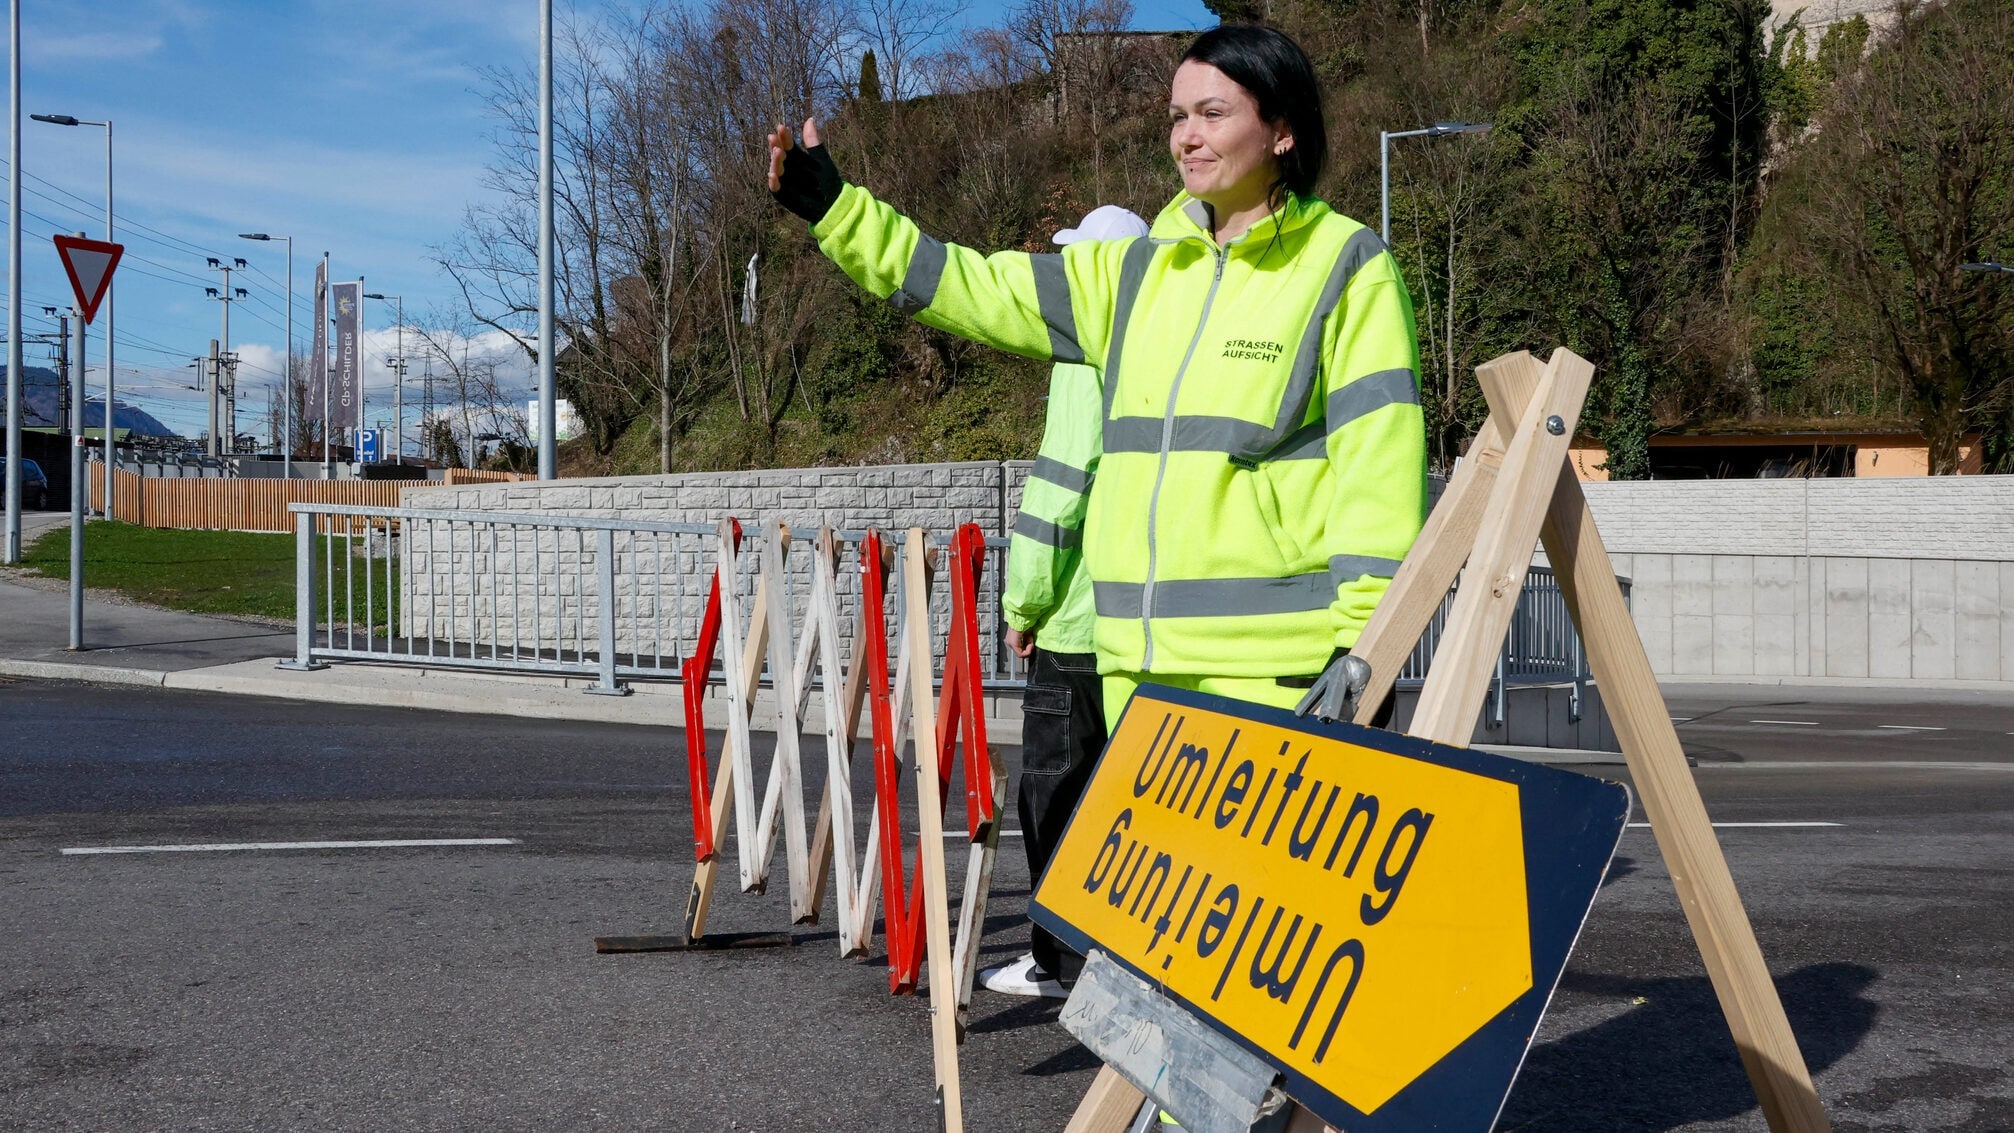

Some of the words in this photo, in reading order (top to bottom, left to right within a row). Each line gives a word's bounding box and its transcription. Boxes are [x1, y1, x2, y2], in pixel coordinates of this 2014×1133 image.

[1225, 339, 1284, 353] STRASSEN
[1222, 350, 1279, 363] AUFSICHT
[358, 431, 373, 449] P
[1133, 712, 1435, 926] Umleitung
[1082, 807, 1365, 1065] Umleitung
